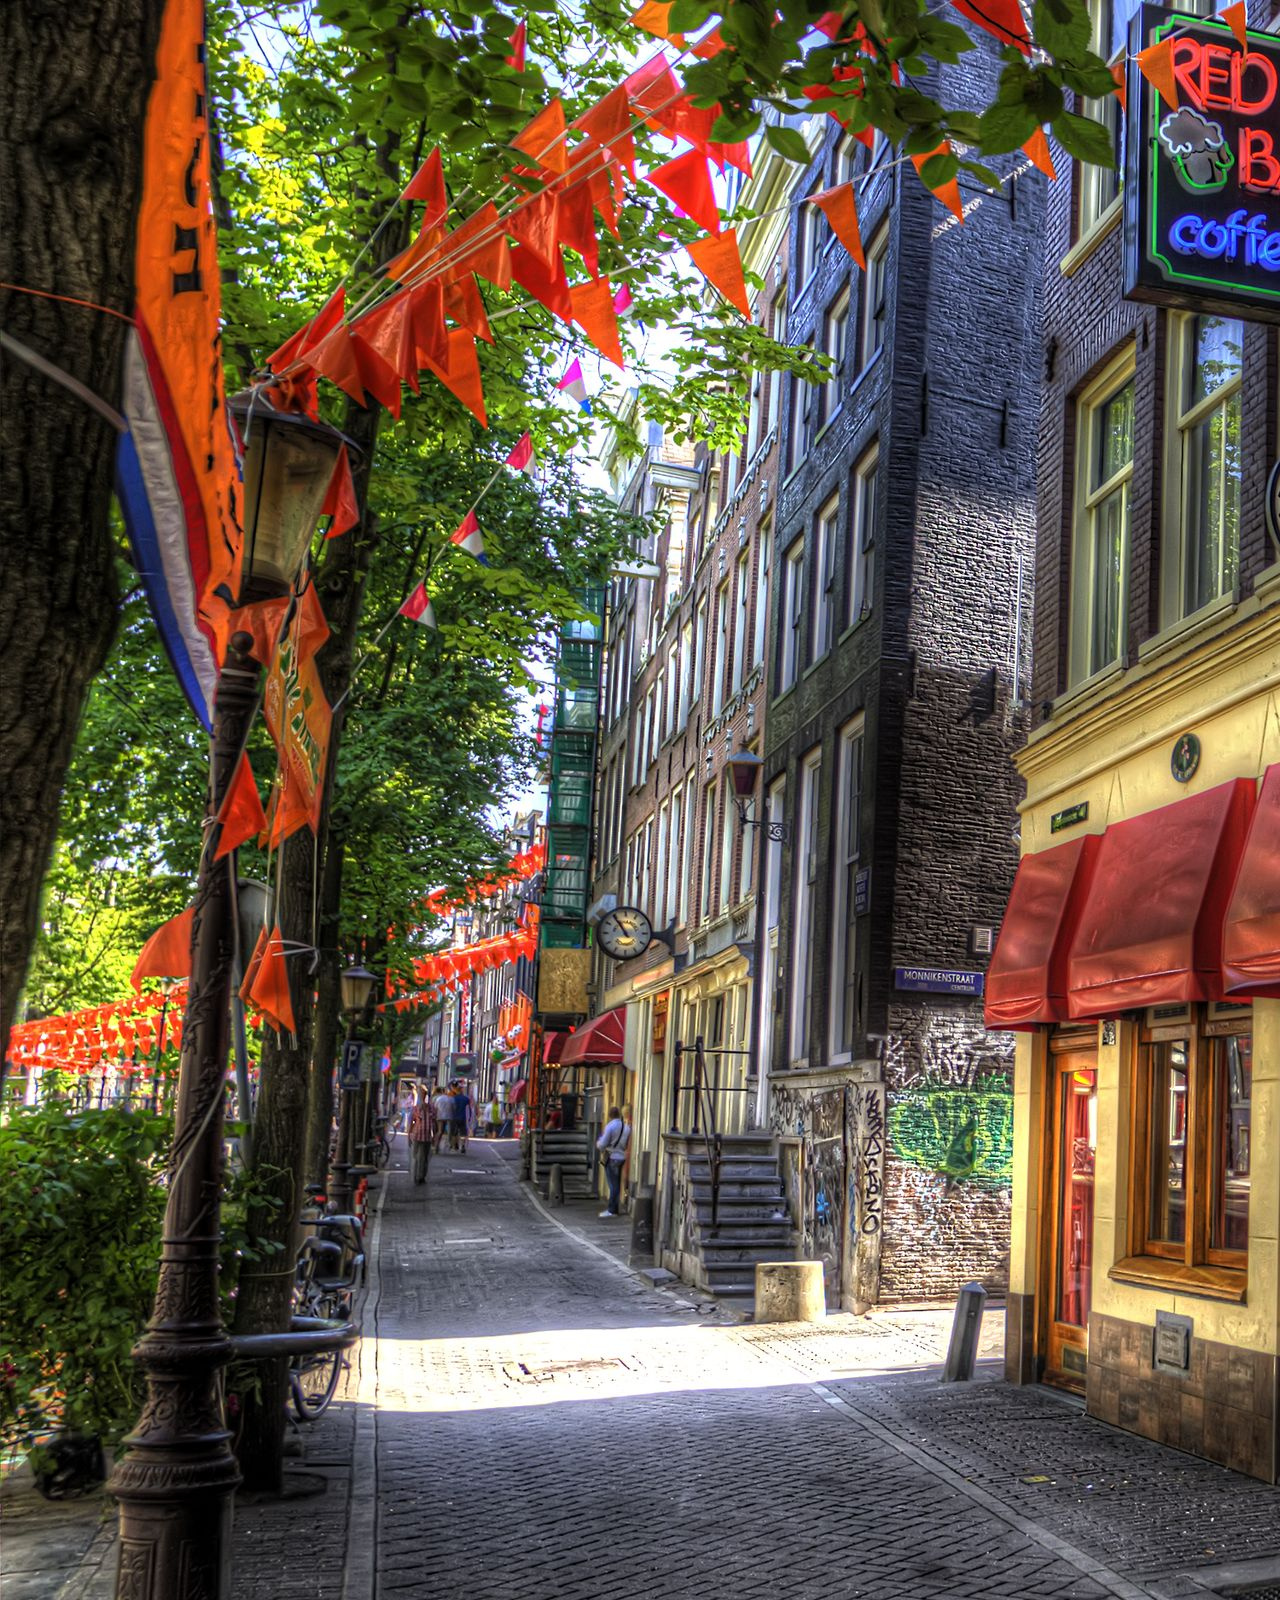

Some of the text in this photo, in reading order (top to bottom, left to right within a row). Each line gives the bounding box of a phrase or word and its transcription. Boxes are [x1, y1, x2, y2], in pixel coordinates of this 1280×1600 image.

[1170, 37, 1277, 115] RED
[904, 970, 976, 984] MONNIKENSTRAAT
[951, 984, 976, 992] CENTRUM
